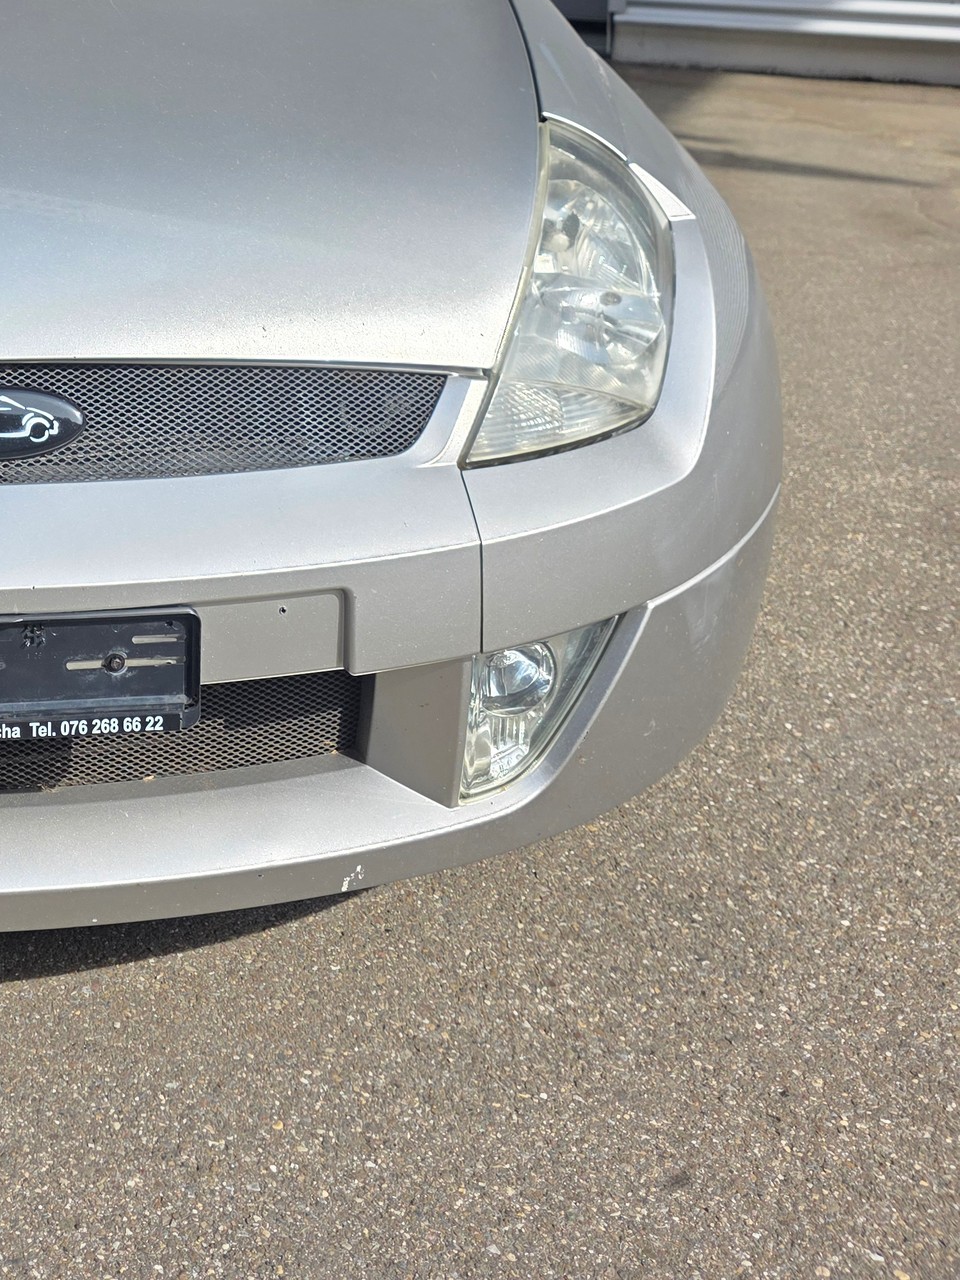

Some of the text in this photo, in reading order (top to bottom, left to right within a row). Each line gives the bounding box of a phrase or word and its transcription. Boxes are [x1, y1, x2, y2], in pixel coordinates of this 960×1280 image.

[29, 721, 56, 738] Tel.
[60, 719, 88, 736] 076
[91, 717, 119, 734] 268
[123, 716, 141, 732] 66
[144, 715, 164, 731] 22
